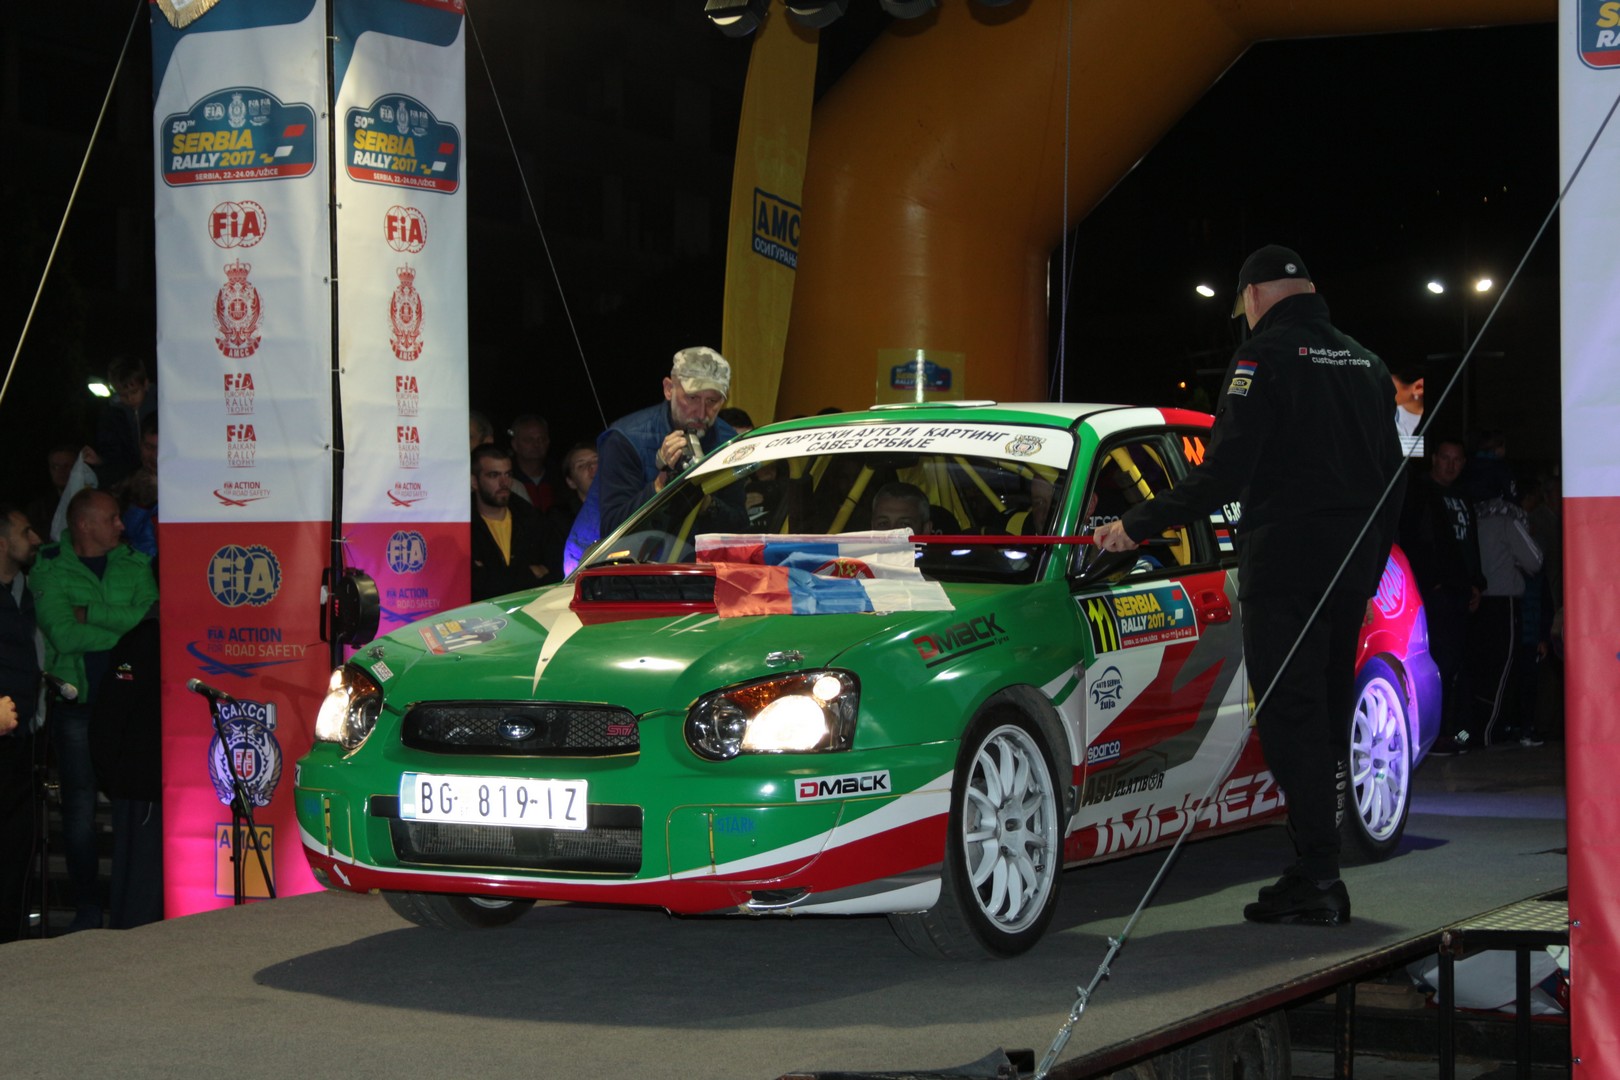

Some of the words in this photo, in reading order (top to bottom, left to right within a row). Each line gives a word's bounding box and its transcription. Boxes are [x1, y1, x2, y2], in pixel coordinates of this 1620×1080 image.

[172, 129, 253, 154] SERBIA
[354, 129, 415, 157] SERBIA
[172, 152, 220, 170] RALLY
[219, 150, 255, 166] 2017
[354, 151, 392, 168] RALLY
[391, 156, 417, 172] 2017
[1309, 347, 1327, 355] Audi
[1327, 348, 1351, 358] Sport
[1311, 356, 1348, 366] customer
[1349, 358, 1371, 368] racing
[226, 398, 254, 406] RALLY
[765, 428, 854, 449] СПОРТСКИ
[856, 427, 900, 439] АУТО
[924, 428, 1010, 442] КАРТИНГ
[806, 438, 861, 452] САВЕЗ
[863, 438, 935, 449] СРБИЈЕ
[227, 450, 256, 460] RALLY
[234, 481, 260, 489] ACTION
[399, 588, 428, 598] ACTION
[1114, 593, 1161, 618] SERBIA
[1121, 615, 1147, 634] RALLY
[1148, 612, 1165, 629] 2017
[229, 627, 282, 642] ACTION
[225, 644, 256, 656] ROAD
[259, 645, 306, 657] SAFETY
[1096, 681, 1106, 689] AUTO
[1088, 740, 1121, 763] sparco
[421, 782, 453, 814] BG
